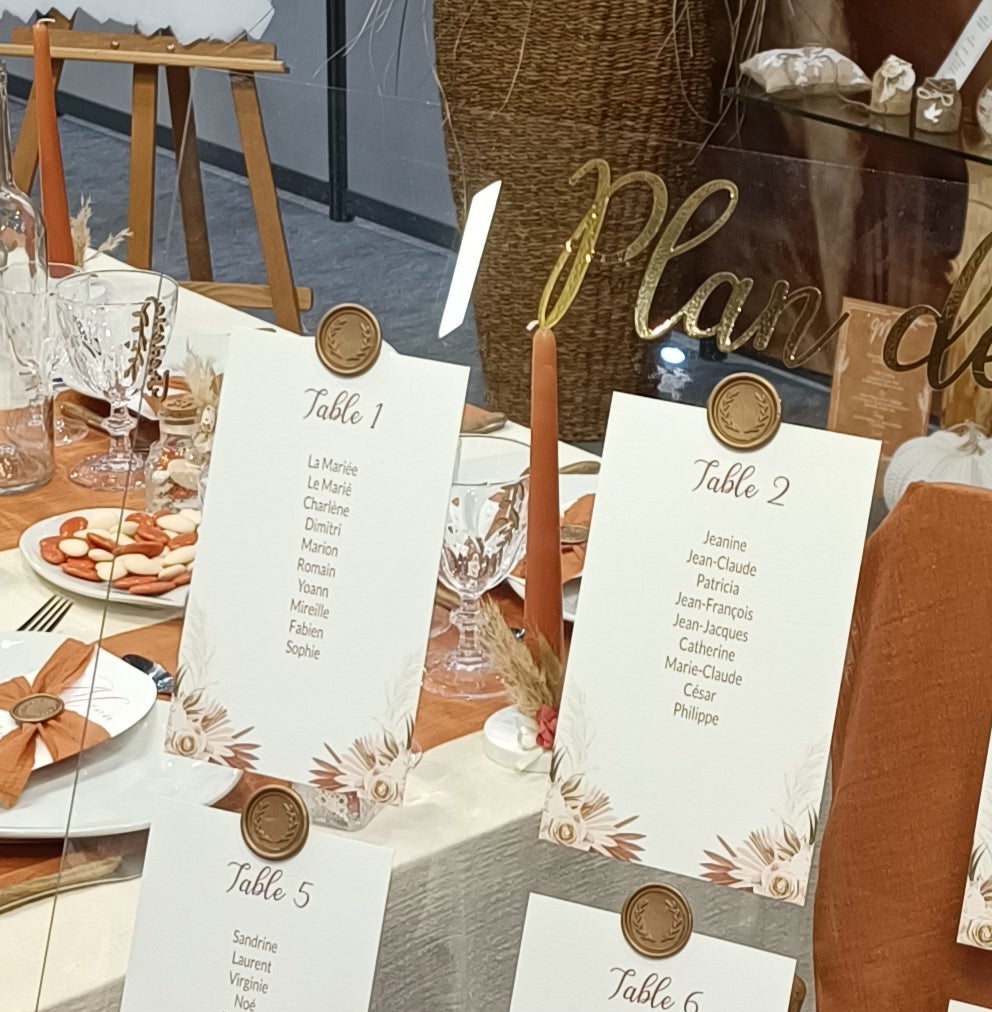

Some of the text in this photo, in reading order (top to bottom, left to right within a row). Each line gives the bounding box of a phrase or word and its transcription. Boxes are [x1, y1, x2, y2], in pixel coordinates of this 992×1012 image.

[537, 159, 849, 367] Plan
[302, 388, 383, 429] Table 1
[308, 455, 358, 477] La Mariée
[308, 476, 351, 496] Le Marié
[692, 459, 789, 506] Table 2
[304, 496, 349, 517] Charlène
[305, 517, 341, 537] Dimitri
[301, 538, 337, 557] Marion
[703, 530, 747, 552] Jeanine
[297, 558, 336, 578] Romain
[687, 549, 756, 576] Jean-Claude
[298, 579, 328, 597] Yoann
[697, 574, 739, 595] Patricia
[290, 599, 329, 619] Mireille
[675, 592, 753, 621] Jean-François
[289, 620, 323, 639] Fabien
[673, 613, 748, 642] Jean-Jacques
[285, 640, 320, 660] Sophie
[679, 637, 735, 662] Catherine
[665, 656, 742, 686] Marie-Claude
[684, 683, 716, 702] César
[673, 702, 719, 726] Philippe
[226, 862, 314, 908] Table 5
[233, 930, 277, 953] Sandrine
[232, 951, 271, 973] Laurent
[229, 971, 268, 994] Virginie
[608, 968, 675, 1010] Table
[234, 994, 255, 1012] Noé
